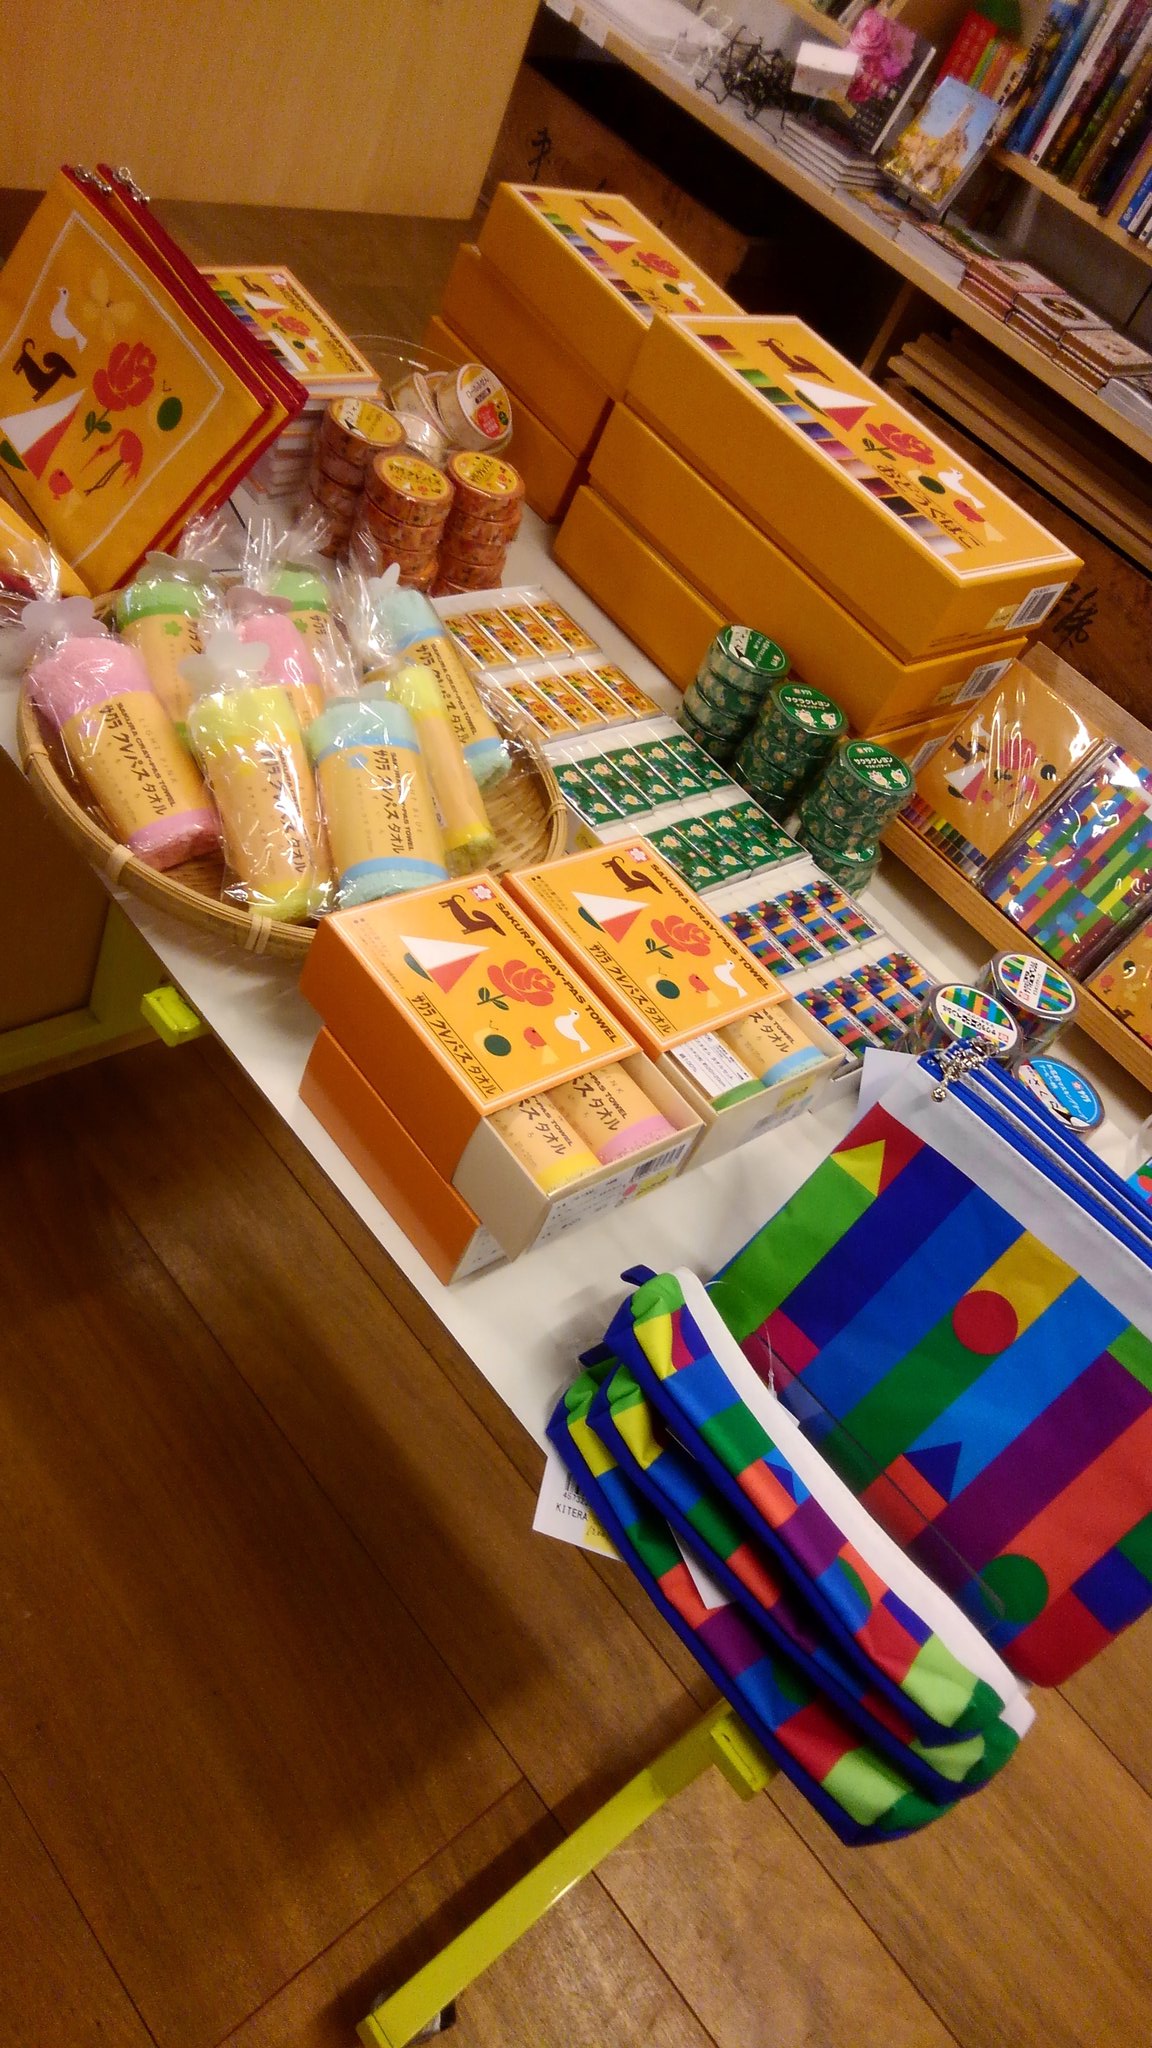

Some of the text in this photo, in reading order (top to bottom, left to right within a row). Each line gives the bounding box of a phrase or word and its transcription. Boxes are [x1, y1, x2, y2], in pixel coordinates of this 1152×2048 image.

[99, 704, 168, 816] サクラ クレパス タオル
[116, 702, 176, 807] SAKURA CRAY-PAS TOWEL
[372, 749, 391, 771] サクラ
[388, 823, 405, 854] タオル
[651, 863, 770, 991] SAKURA CRAY-PAS TOWEL
[495, 902, 538, 948] SAKURA
[535, 947, 587, 1005] CRAY-PAS
[584, 1005, 618, 1043] TOWEL
[591, 944, 671, 1034] サクラ クレパス タオル
[411, 994, 497, 1096] サクラ クレパス タオル
[759, 1024, 789, 1054] タオル
[773, 1021, 795, 1044] TOWEL
[535, 1121, 566, 1155] タオル
[550, 1120, 574, 1147] TOWEL
[589, 1097, 620, 1131] タオル
[605, 1092, 628, 1119] TOWEL
